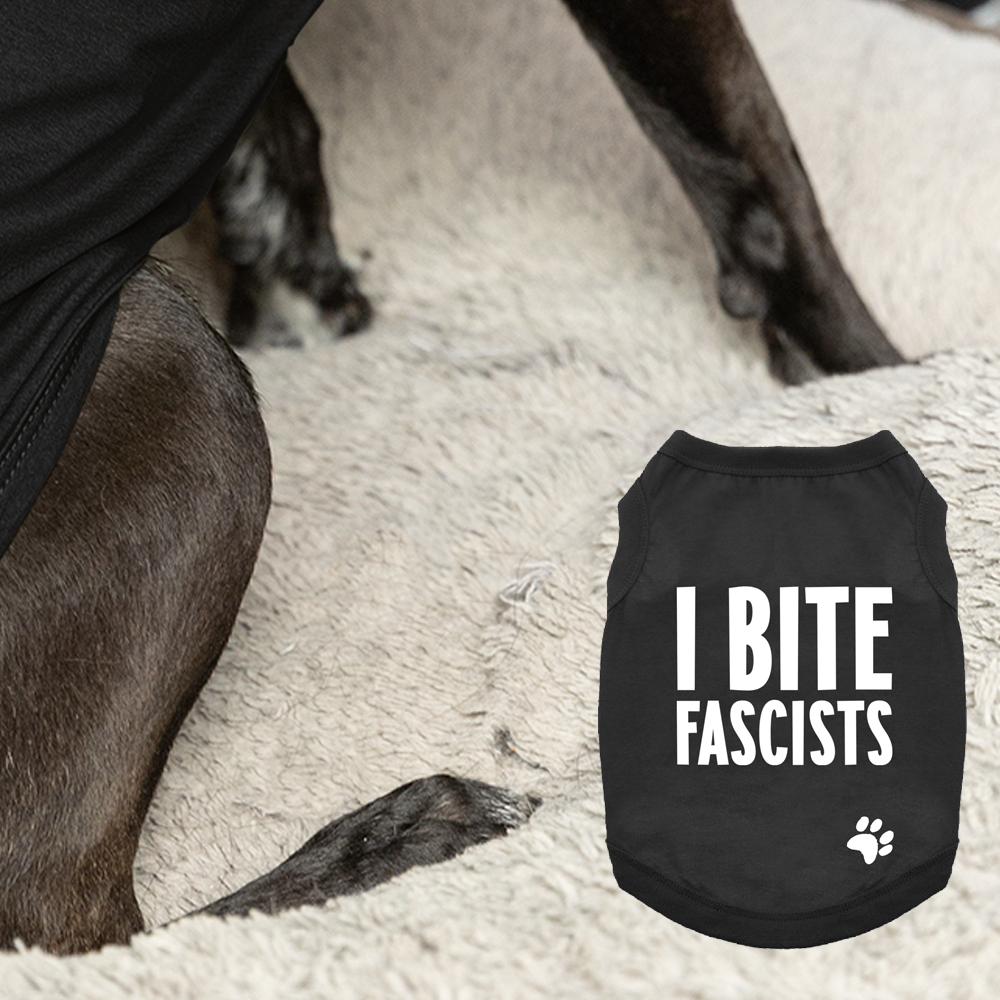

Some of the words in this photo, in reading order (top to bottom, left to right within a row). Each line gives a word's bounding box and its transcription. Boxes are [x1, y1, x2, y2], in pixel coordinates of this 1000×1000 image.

[676, 586, 696, 691] I
[728, 585, 893, 692] BITE
[676, 699, 893, 766] FASCISTS
